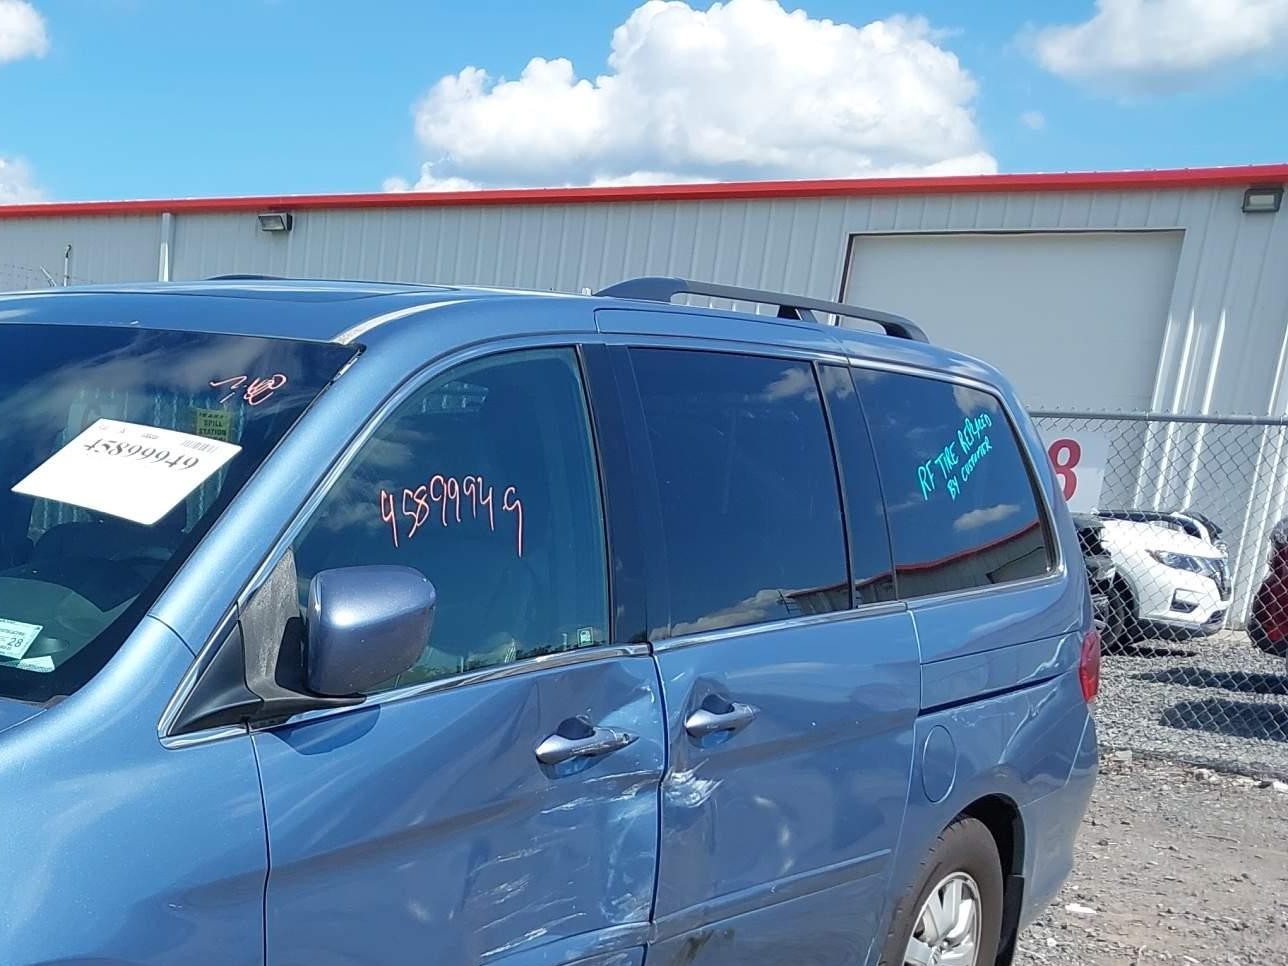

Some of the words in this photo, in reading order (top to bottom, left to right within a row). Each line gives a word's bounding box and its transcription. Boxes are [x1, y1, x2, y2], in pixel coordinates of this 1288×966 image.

[84, 438, 199, 470] 45899949
[918, 459, 935, 500] RF
[934, 441, 959, 479] TIRE
[947, 475, 960, 500] BY
[7, 637, 24, 648] 28
